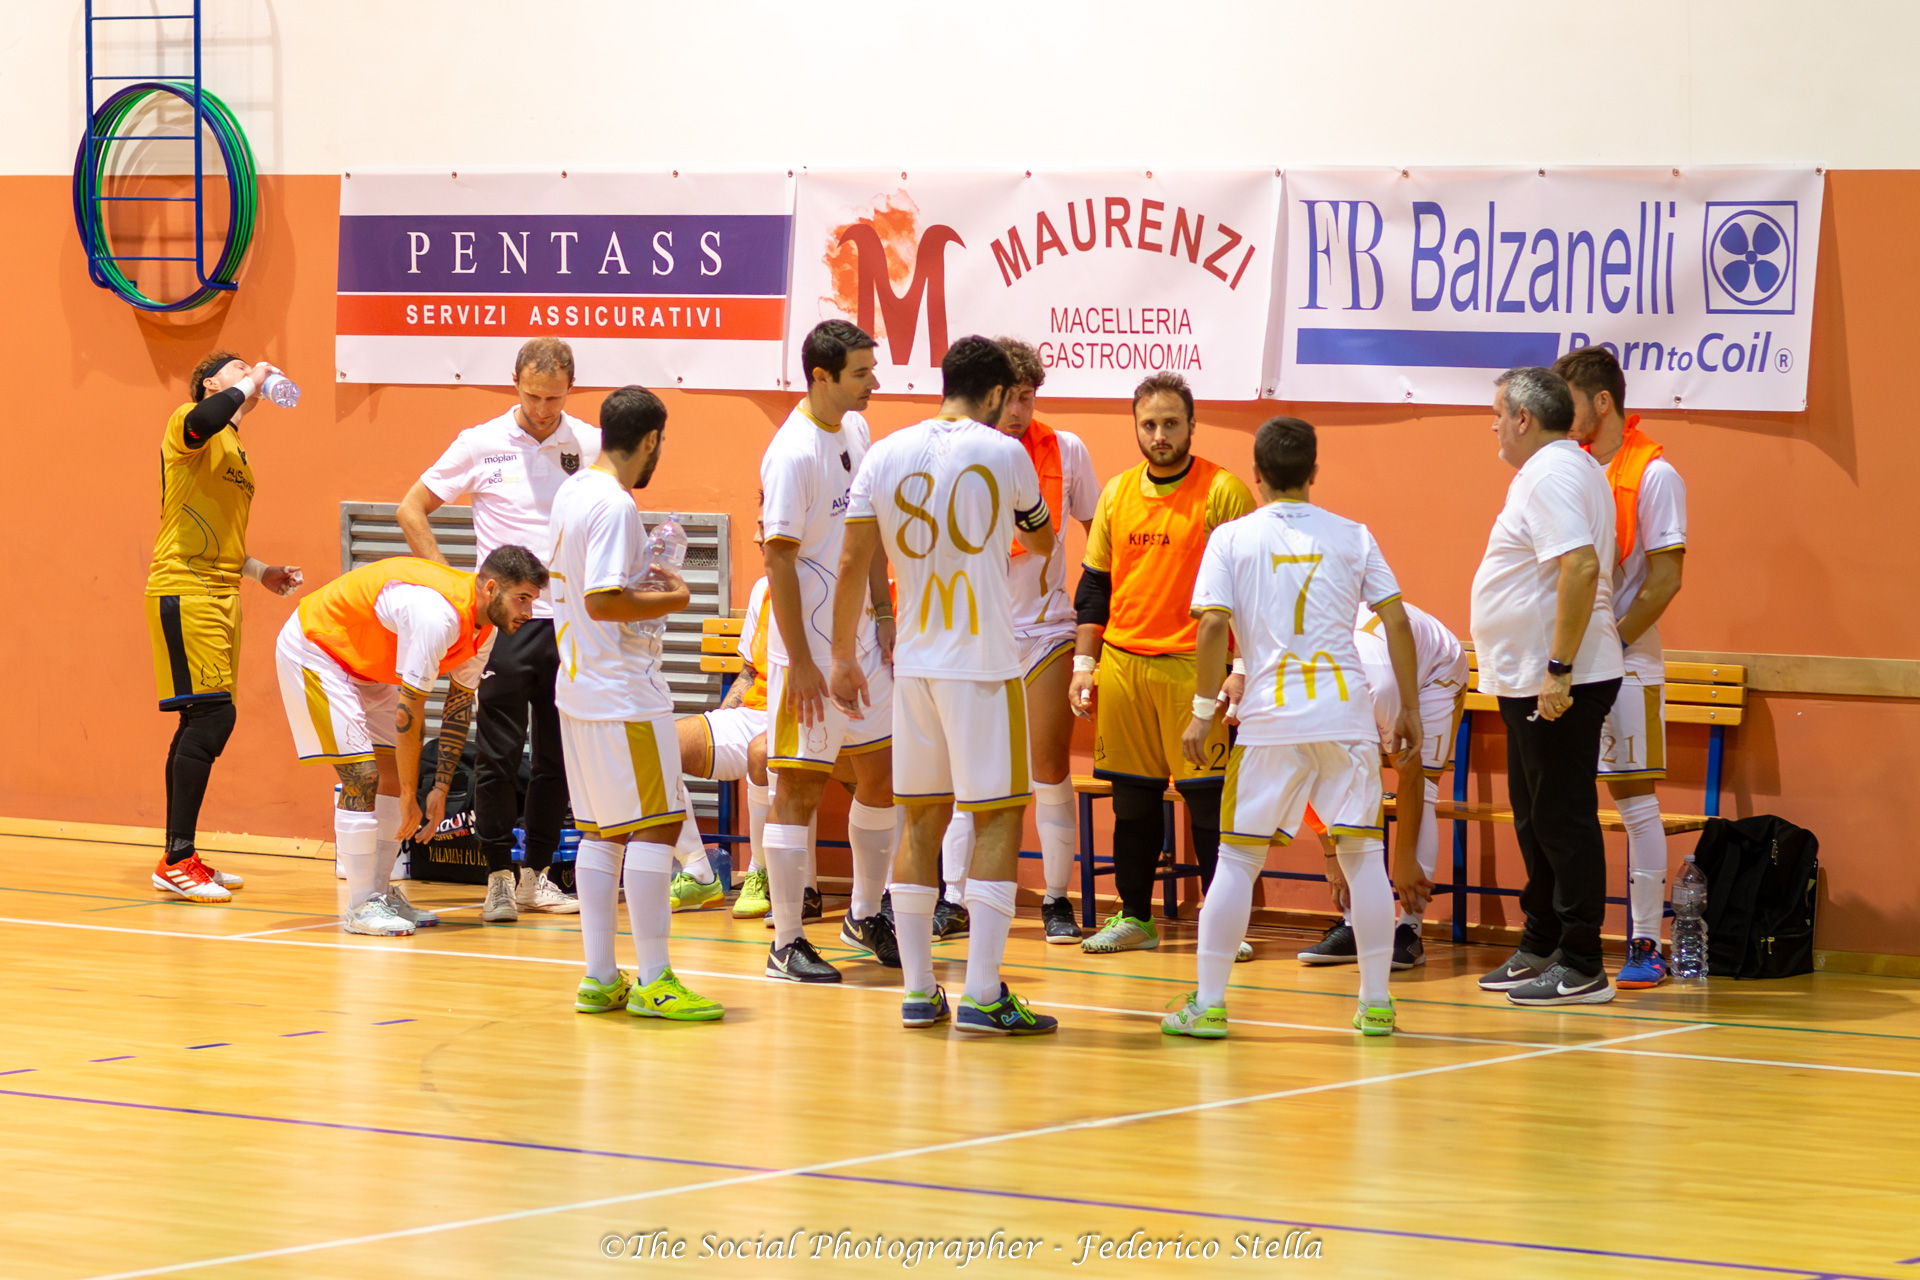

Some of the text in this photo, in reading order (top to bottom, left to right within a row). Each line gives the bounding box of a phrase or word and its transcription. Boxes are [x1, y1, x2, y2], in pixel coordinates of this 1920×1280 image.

[406, 230, 722, 276] PENTASS
[990, 197, 1256, 291] MAURENZI
[1411, 201, 1676, 315] Balzanelli
[406, 305, 722, 328] SERVIZI ASSICURATIVI
[1051, 307, 1192, 335] MACELLERIA
[1039, 342, 1202, 370] GASTRONOMIA
[895, 463, 999, 559] 80
[1129, 533, 1170, 545] KIPSTA
[1271, 552, 1323, 635] 7
[1601, 734, 1637, 764] 21
